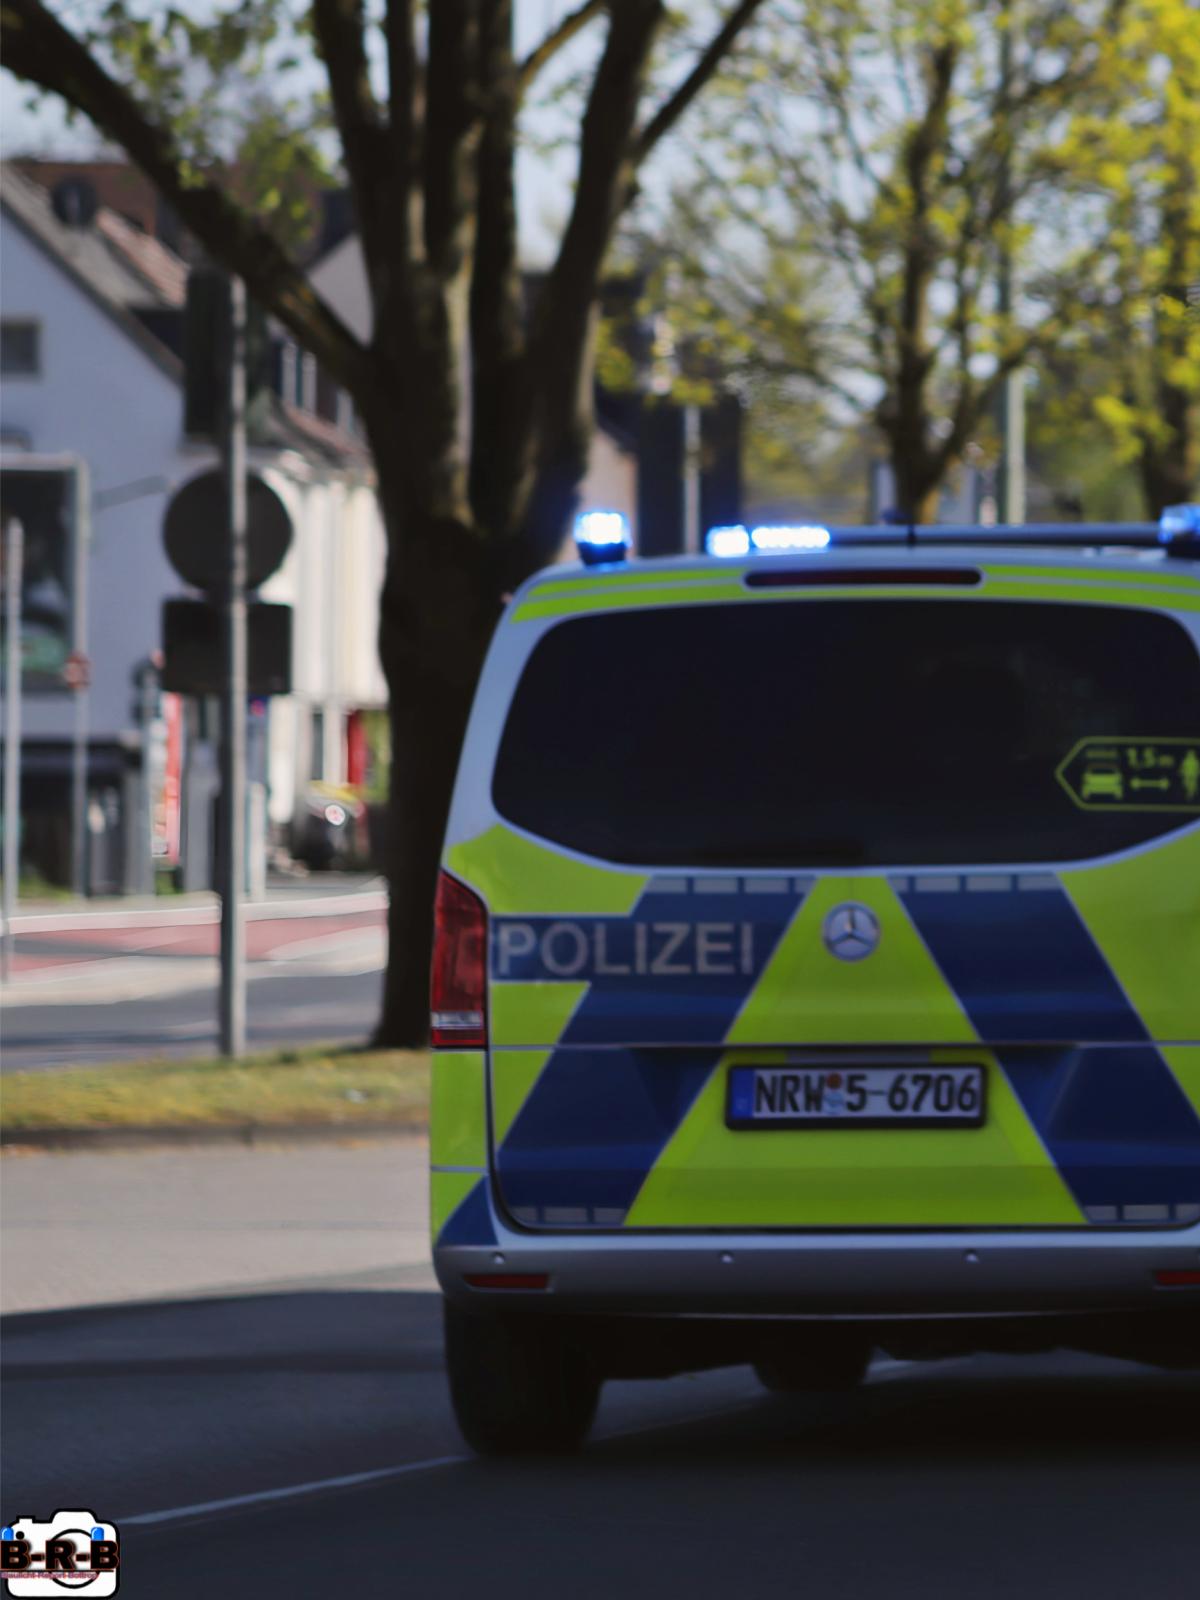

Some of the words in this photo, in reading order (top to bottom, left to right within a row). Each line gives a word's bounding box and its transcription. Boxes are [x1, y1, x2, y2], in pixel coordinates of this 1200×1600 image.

[497, 922, 754, 976] POLIZEI
[754, 1073, 826, 1113] NRW
[845, 1072, 977, 1113] 5-6706
